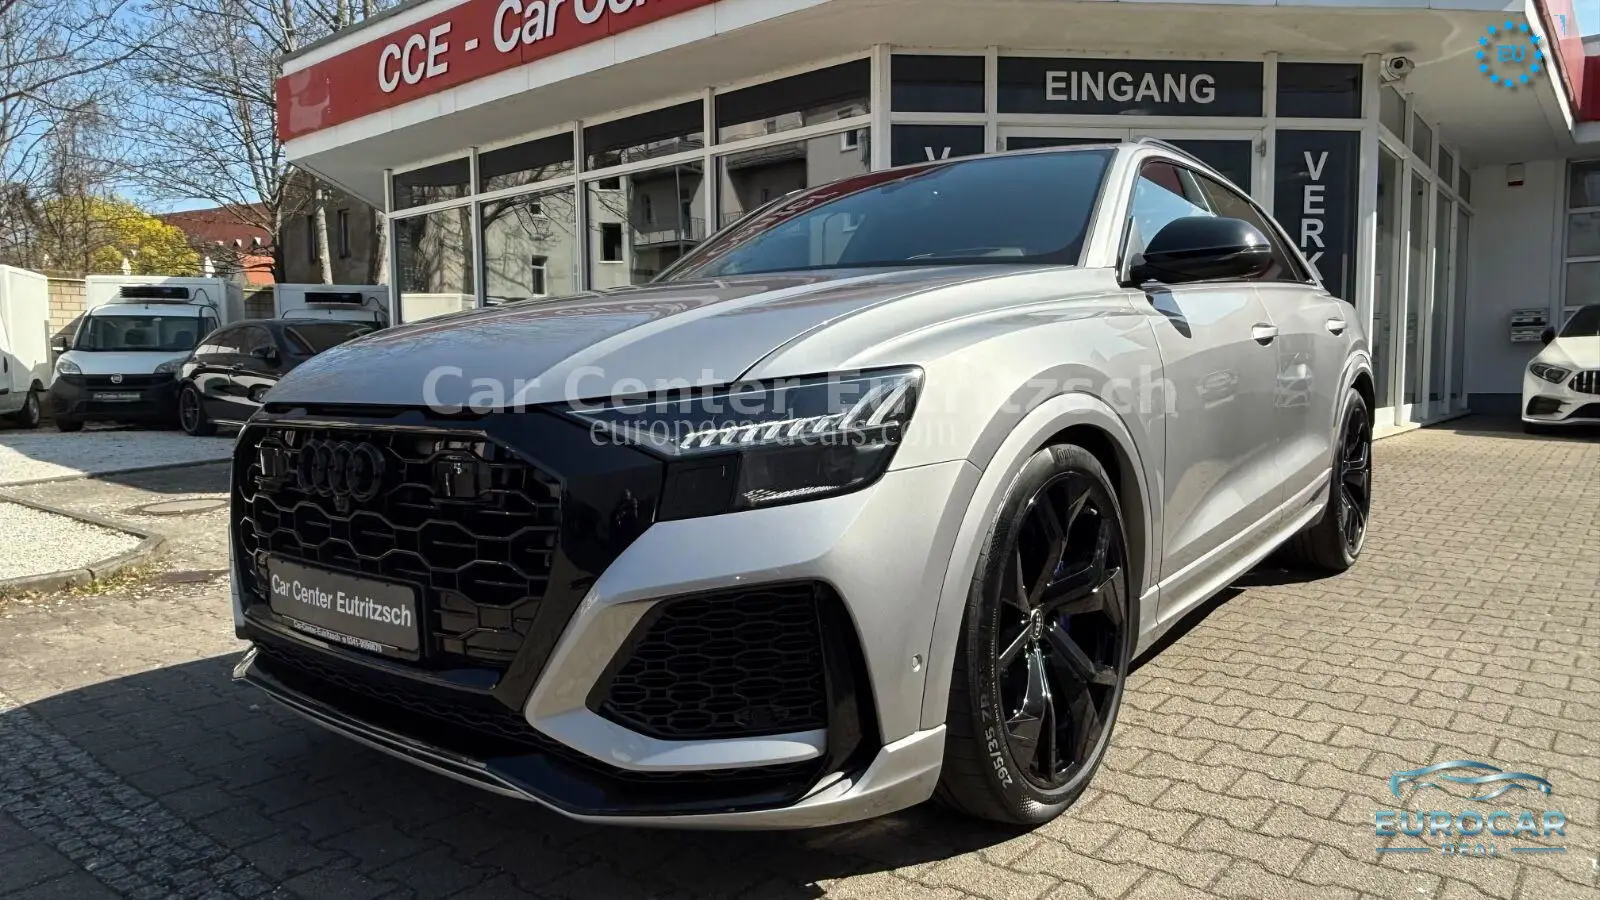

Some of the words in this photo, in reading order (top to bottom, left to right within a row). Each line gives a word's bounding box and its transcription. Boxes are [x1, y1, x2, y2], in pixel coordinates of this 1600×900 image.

[378, 22, 450, 93] CCE
[493, 0, 558, 53] Car
[1045, 71, 1215, 104] EINGANG
[271, 574, 291, 597] Car
[292, 580, 333, 609] Center
[336, 591, 411, 627] Eutritzsch
[984, 726, 1013, 789] 295/35
